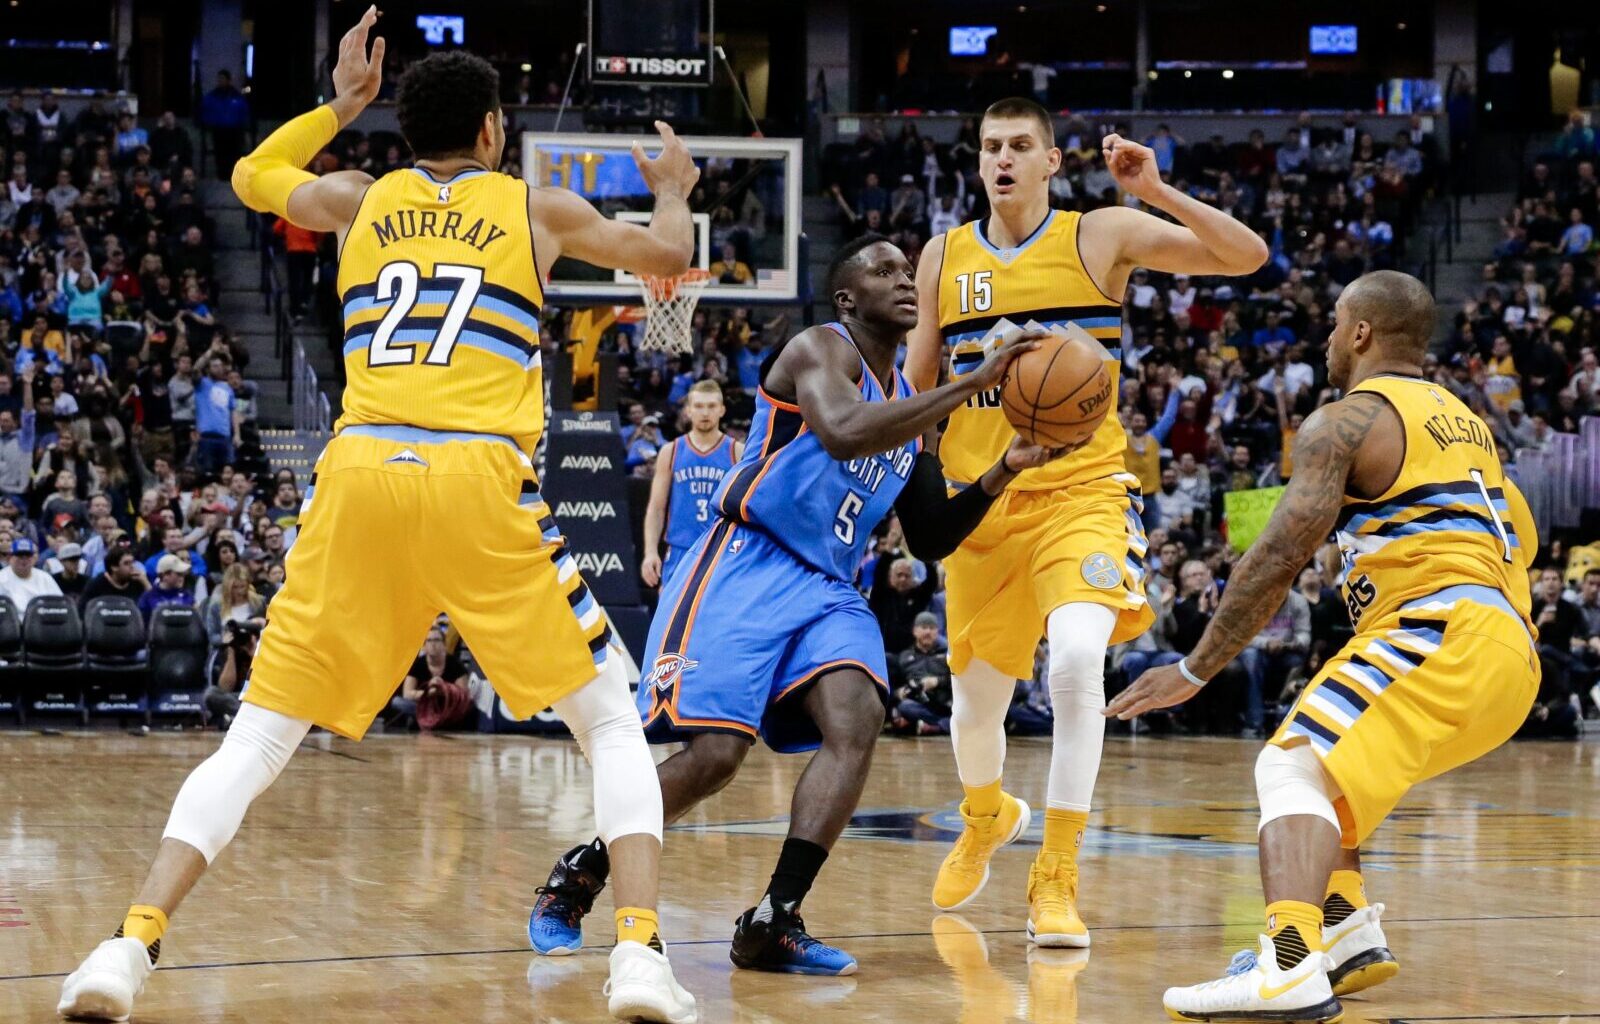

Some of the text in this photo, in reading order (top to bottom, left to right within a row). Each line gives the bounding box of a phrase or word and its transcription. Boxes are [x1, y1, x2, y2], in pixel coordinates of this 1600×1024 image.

[627, 57, 706, 76] TISSOT
[371, 210, 507, 252] MURRAY
[956, 270, 993, 315] 15
[367, 260, 485, 368] 27
[562, 419, 612, 432] SPALDING
[1424, 413, 1493, 457] NELSON
[560, 455, 612, 473] AVAYA
[675, 466, 725, 483] OKLAHOM
[690, 481, 714, 495] CITY
[555, 501, 616, 522] AVAYA
[696, 499, 709, 522] 3
[833, 489, 865, 547] 5
[1468, 467, 1512, 565] 1
[573, 552, 625, 577] VAYA
